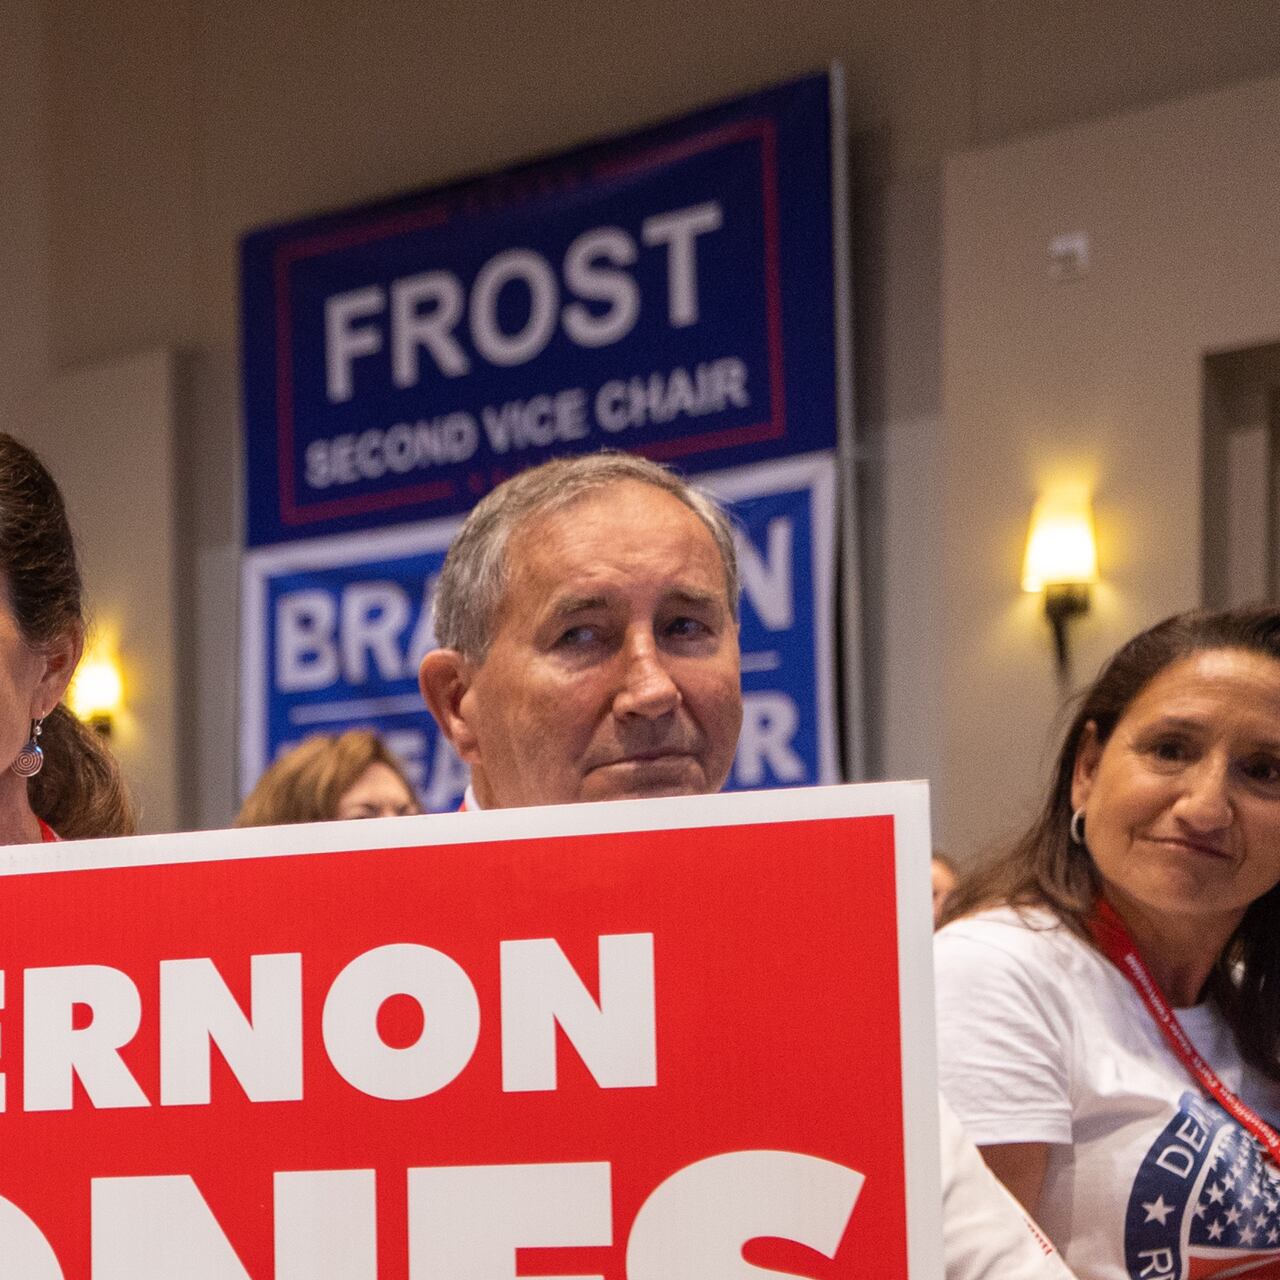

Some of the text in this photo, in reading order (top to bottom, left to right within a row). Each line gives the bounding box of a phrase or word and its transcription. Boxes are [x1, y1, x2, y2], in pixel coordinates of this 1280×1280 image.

[325, 202, 723, 402] FROST
[305, 355, 750, 490] SECOND VICE CHAIR
